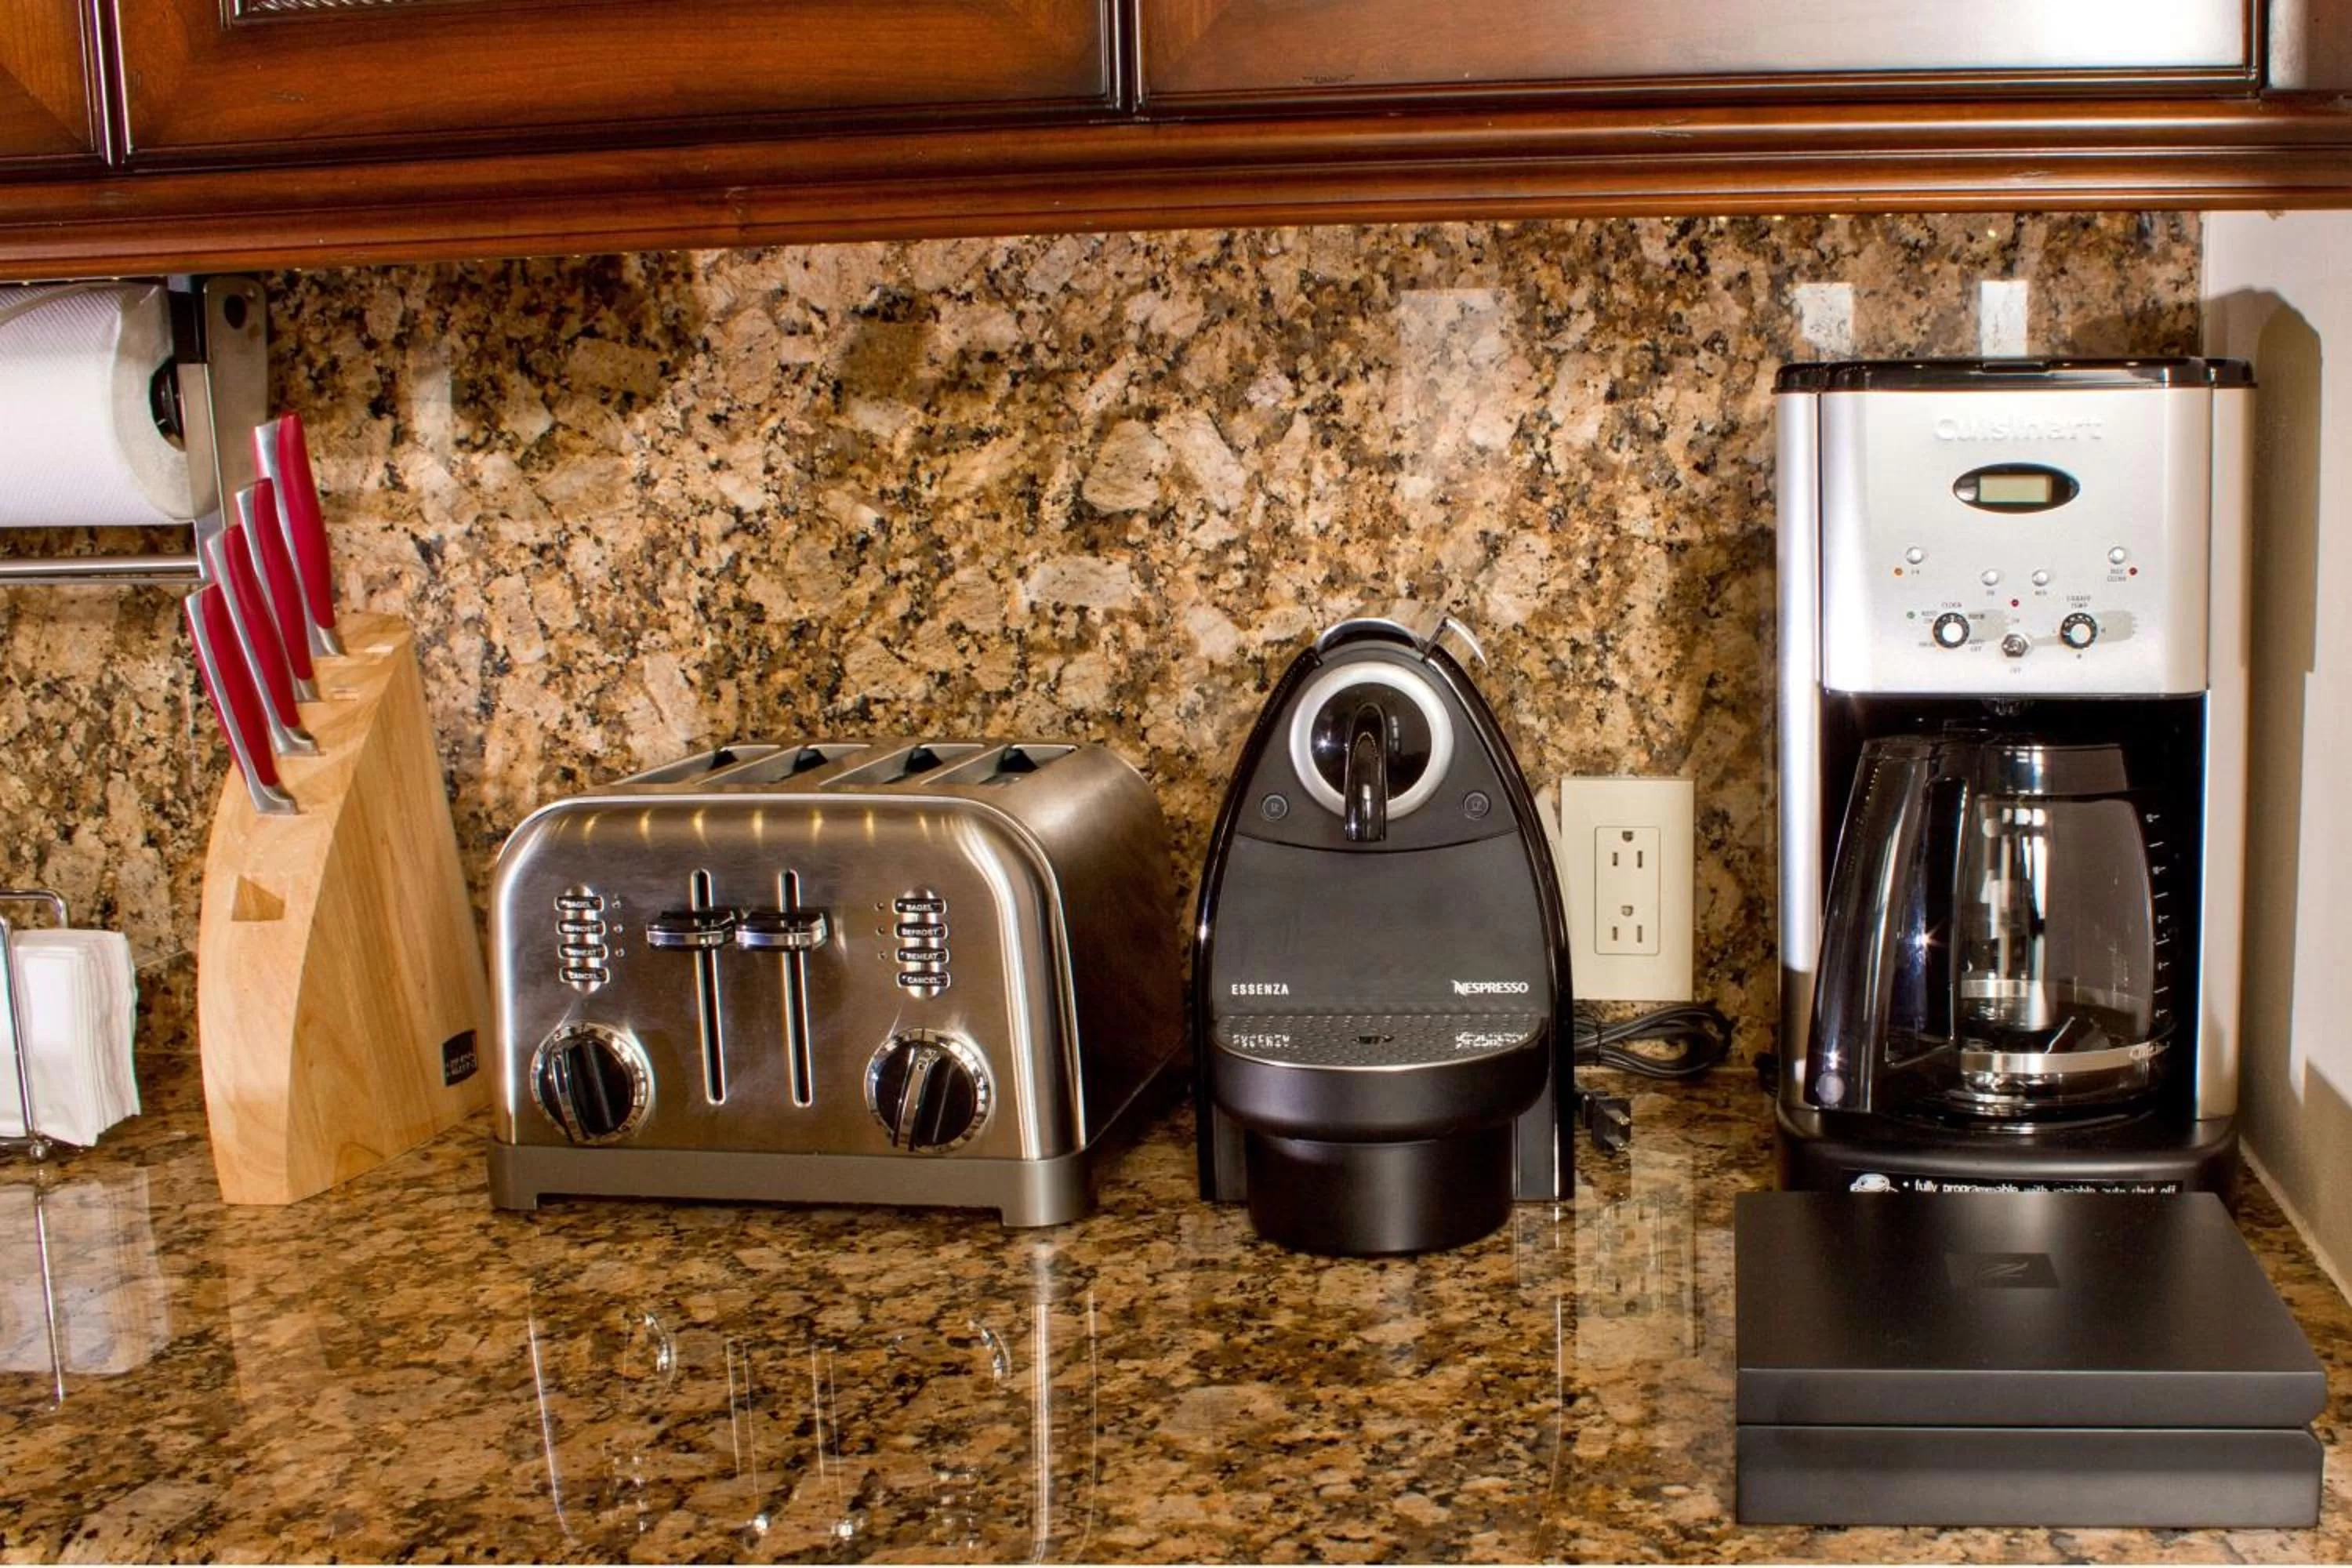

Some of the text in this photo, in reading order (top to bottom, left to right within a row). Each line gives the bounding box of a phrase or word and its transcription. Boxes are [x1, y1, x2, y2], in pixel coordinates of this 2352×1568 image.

[906, 903, 933, 912] BAGEL
[907, 975, 941, 984] CANCEL
[1231, 983, 1290, 996] ESSENZA
[1451, 980, 1530, 996] NESPRESSO
[1915, 1178, 1938, 1192] fully
